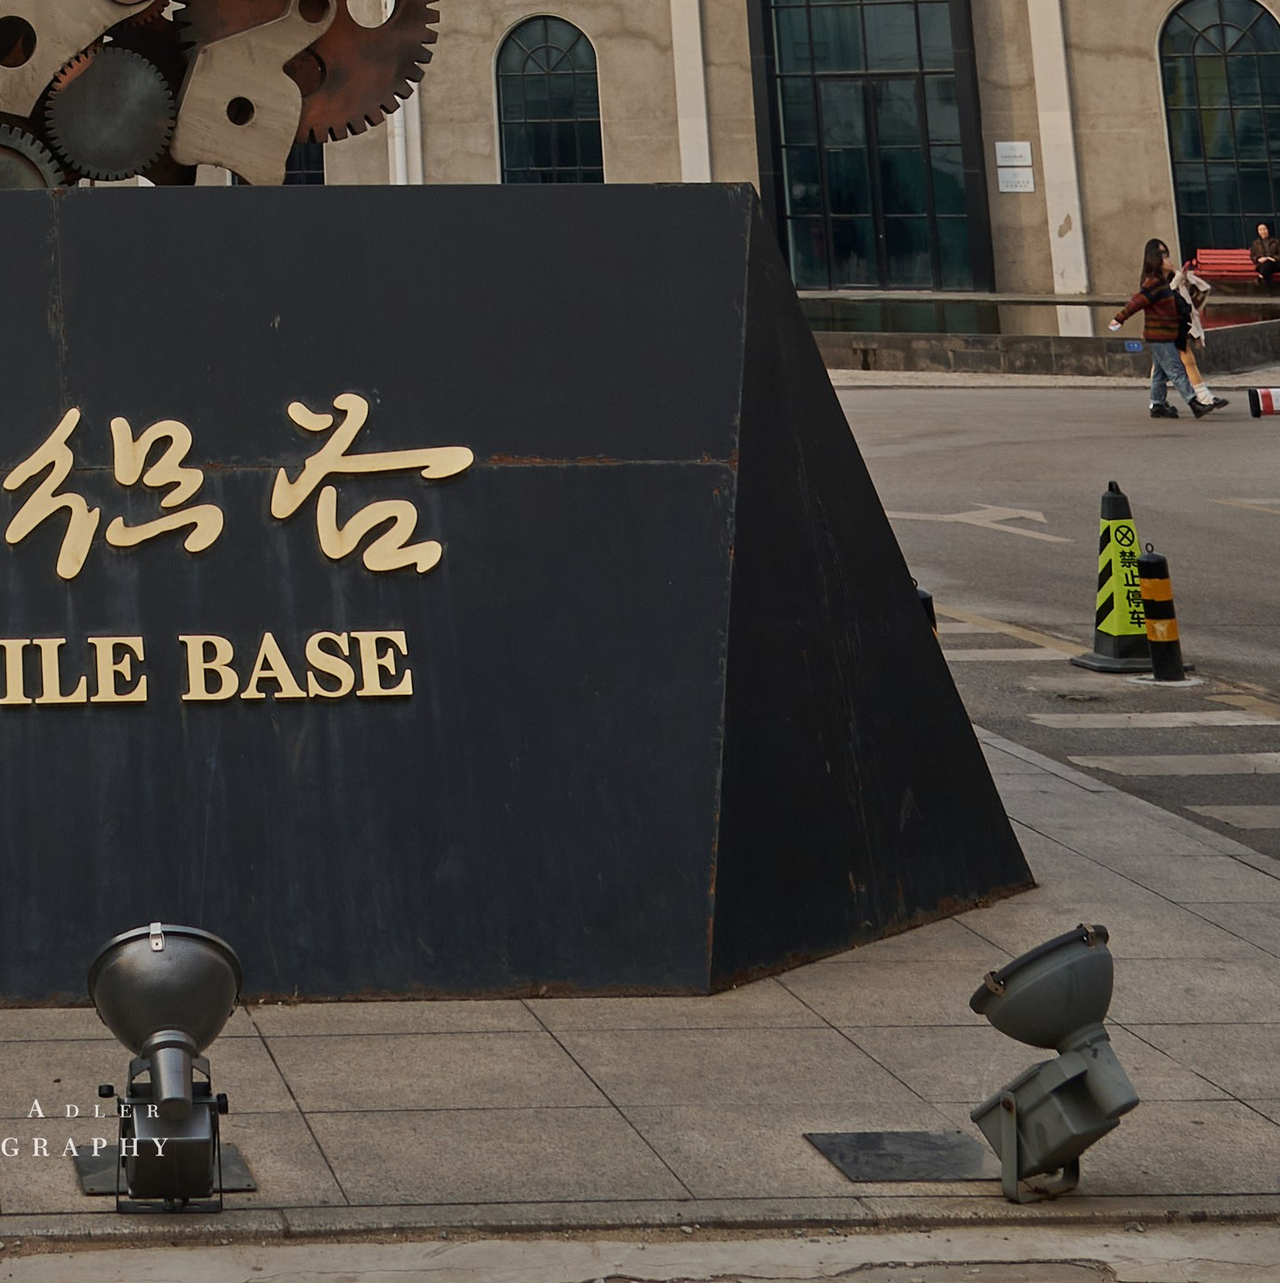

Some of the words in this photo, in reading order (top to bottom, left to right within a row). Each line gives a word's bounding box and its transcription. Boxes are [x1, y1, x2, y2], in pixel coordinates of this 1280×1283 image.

[1118, 550, 1146, 629] 禁止停车
[179, 630, 415, 702] BASE
